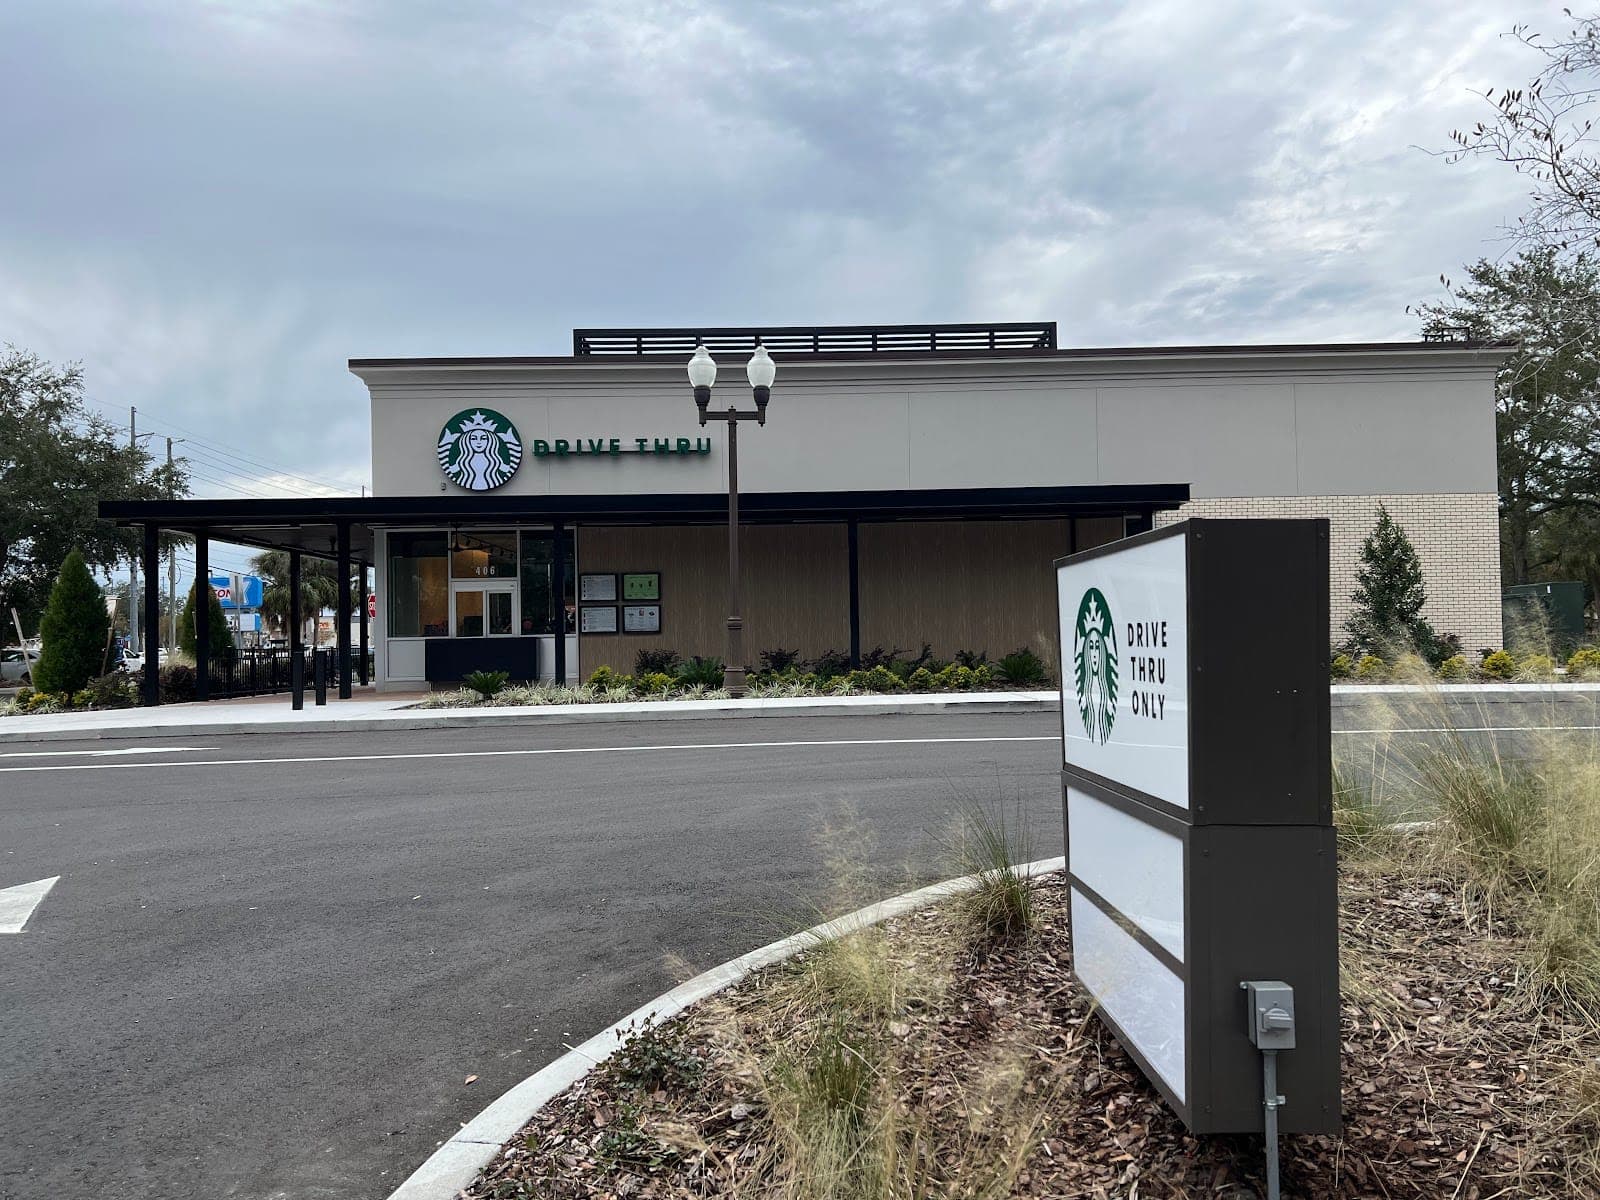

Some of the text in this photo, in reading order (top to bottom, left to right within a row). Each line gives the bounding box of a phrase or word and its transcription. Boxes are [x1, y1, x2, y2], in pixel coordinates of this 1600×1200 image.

[533, 437, 711, 457] DRIVE THRU
[475, 565, 495, 576] 406
[1127, 621, 1167, 648] DRIVE
[1130, 656, 1165, 684] THRU
[1132, 690, 1165, 721] ONLY
